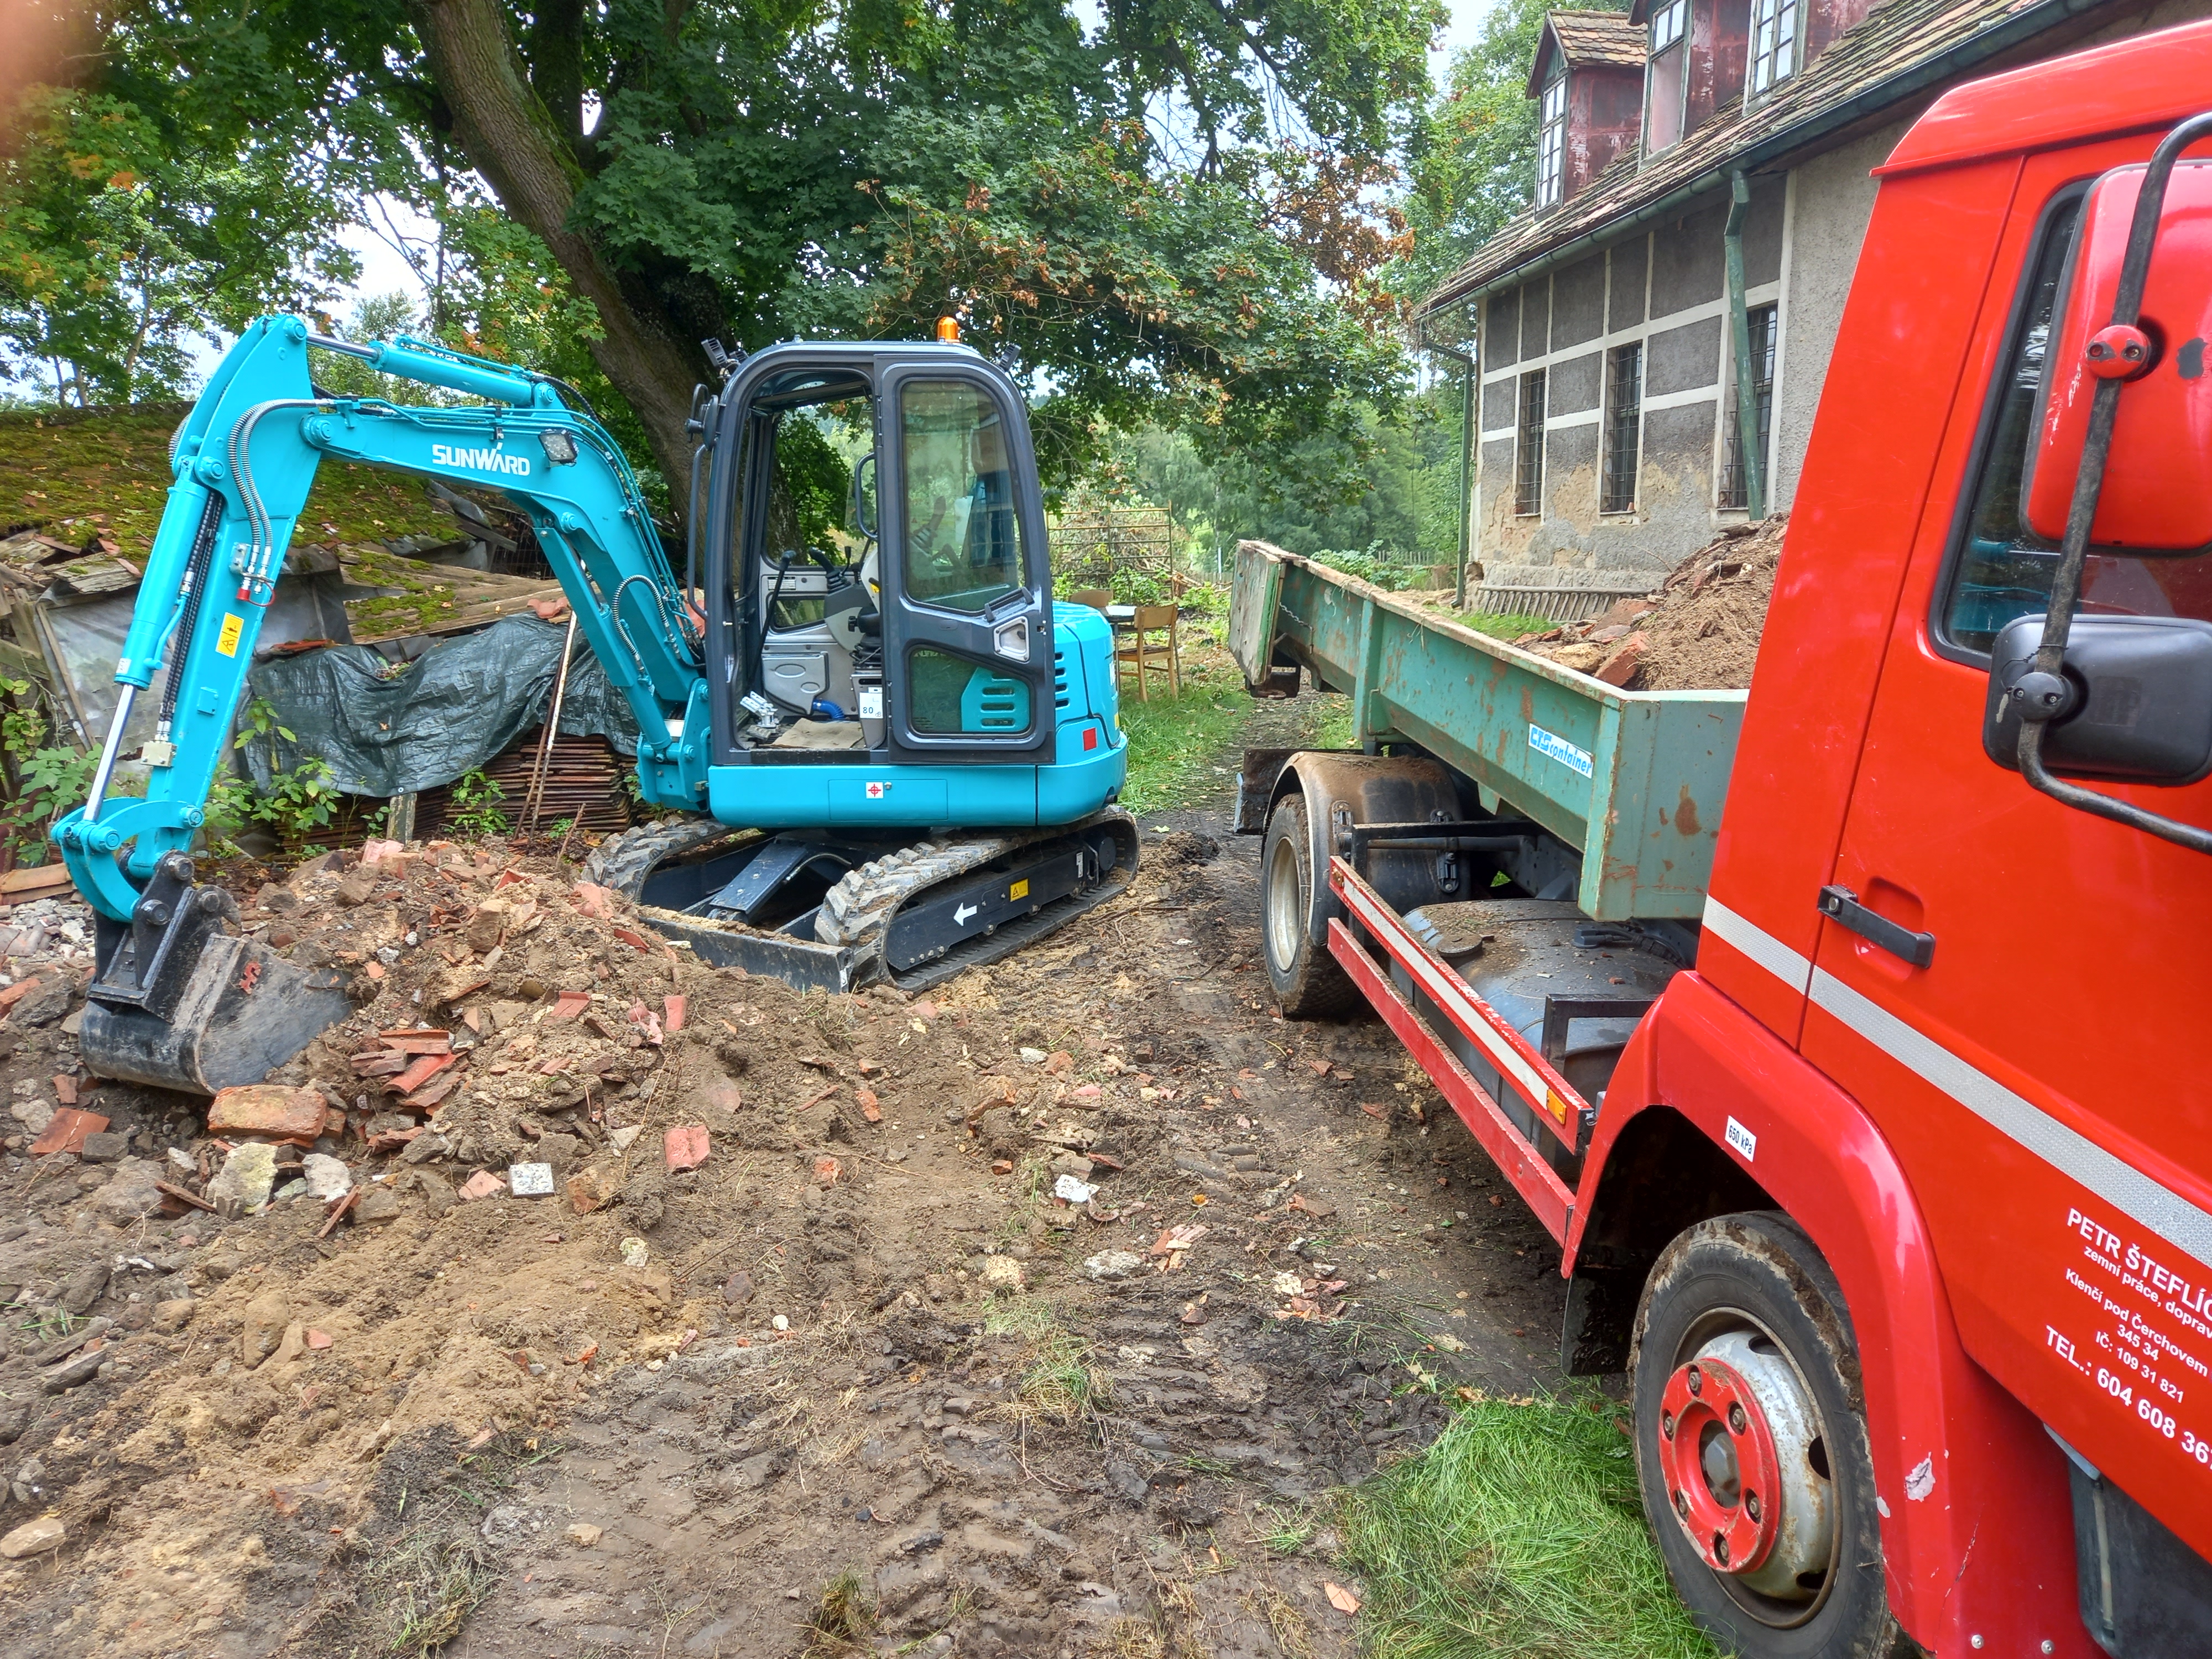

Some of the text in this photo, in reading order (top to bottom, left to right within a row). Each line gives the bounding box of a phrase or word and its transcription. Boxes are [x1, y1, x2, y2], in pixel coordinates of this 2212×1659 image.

[432, 442, 530, 476] SUNWARD
[1729, 1125, 1752, 1154] 650 kPa
[2067, 1208, 2121, 1259] PETR
[2121, 1272, 2162, 1307] práce,
[2065, 1268, 2208, 1377] Klenčí pod Čerchovem
[2117, 1324, 2159, 1361] 345 34
[2095, 1331, 2184, 1404] IČ: 109 31 821
[2046, 1324, 2212, 1470] TEL.: 604 608 36
